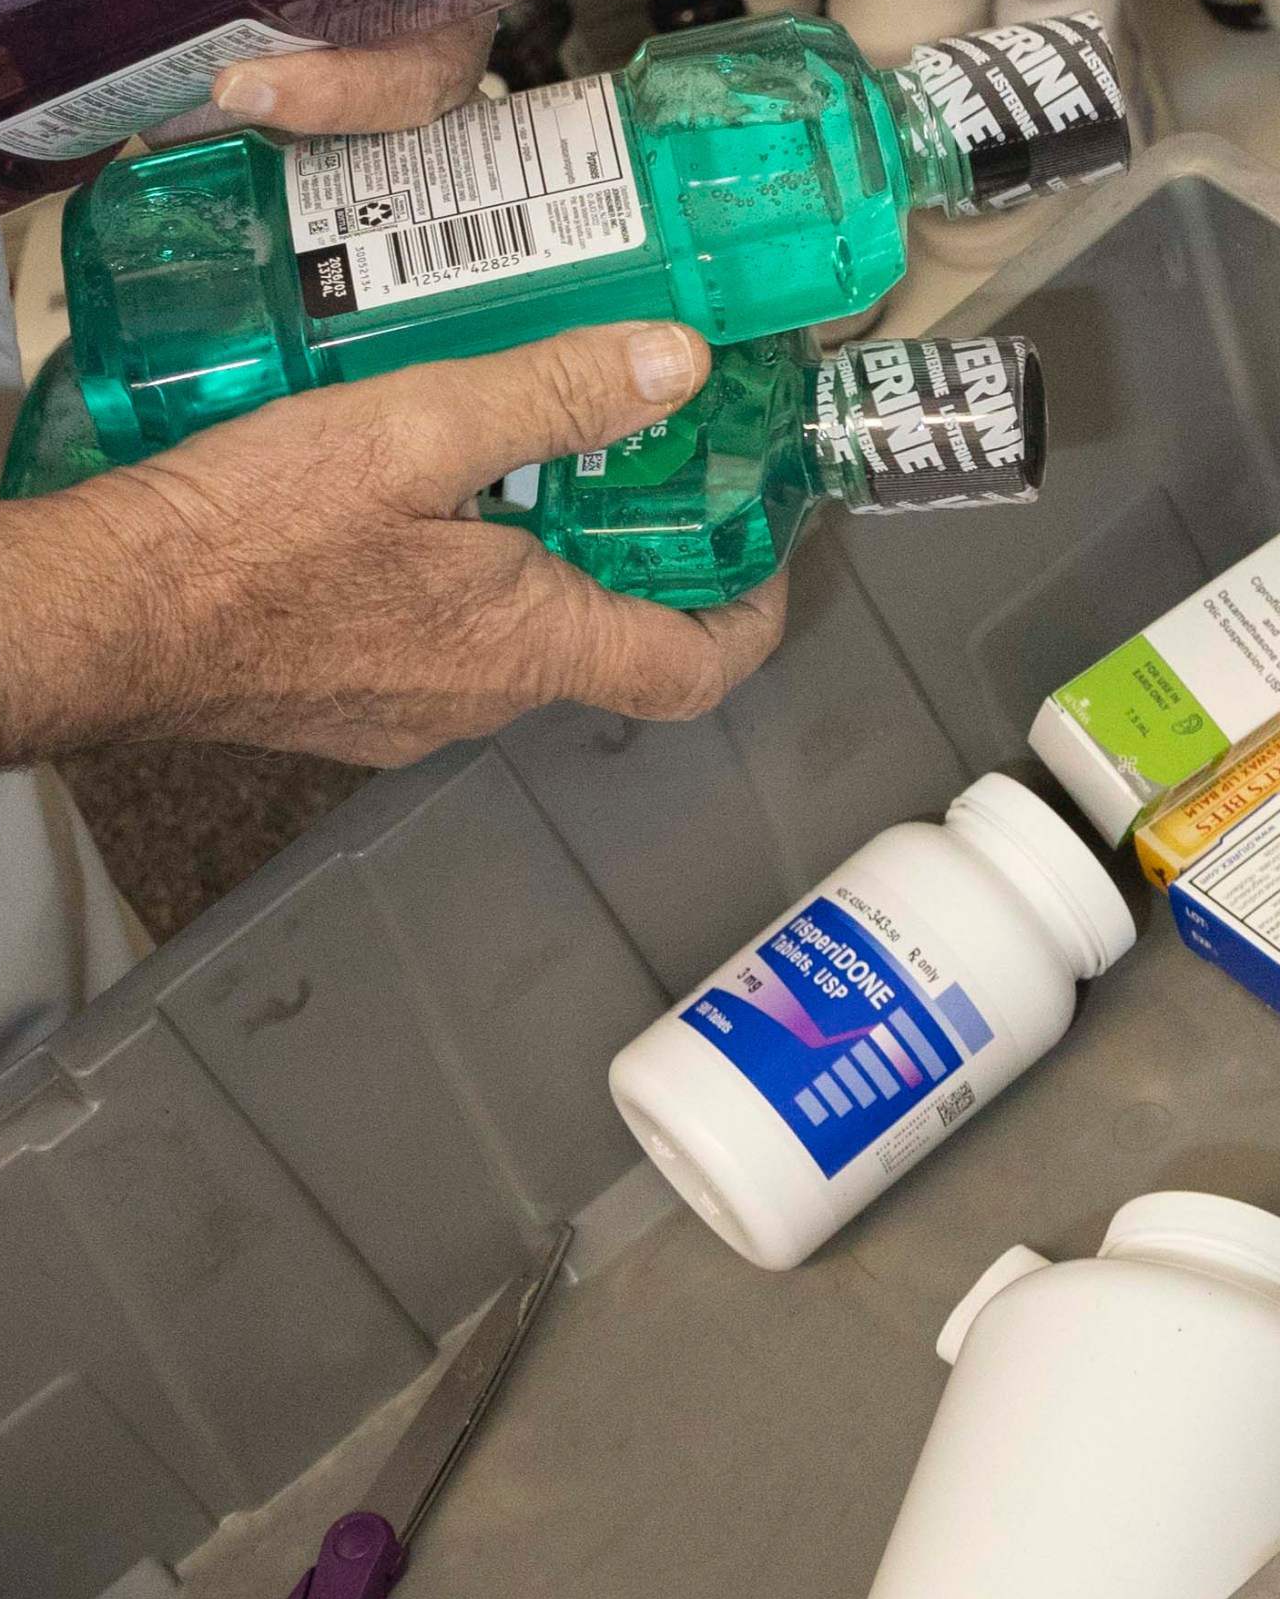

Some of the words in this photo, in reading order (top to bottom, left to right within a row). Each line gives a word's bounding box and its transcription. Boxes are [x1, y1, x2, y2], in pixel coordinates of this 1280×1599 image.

[1079, 40, 1126, 120] LISTERINE
[986, 66, 1039, 140] LISTERINE
[586, 151, 601, 179] Purposes
[335, 210, 347, 232] BOTTLE
[344, 207, 356, 230] PLASTIC
[603, 188, 615, 217] CONSUMER
[611, 187, 622, 212] JOHNSON
[618, 217, 629, 243] JOHNSON
[316, 261, 334, 297] 13724L
[326, 256, 348, 297] 2026/03
[353, 246, 373, 291] 30052134
[413, 266, 462, 287] 12547
[469, 252, 520, 274] 42825
[543, 248, 551, 257] 5
[939, 404, 978, 473] LISTERINE
[1203, 598, 1222, 618] Otic
[1218, 618, 1267, 675] Suspension,
[1218, 589, 1278, 661] Dexamethasone
[1262, 617, 1280, 636] and
[1132, 669, 1152, 691] EARS
[1148, 689, 1169, 712] ONLY
[1143, 661, 1160, 679] FOR
[1156, 677, 1173, 695] USE
[1170, 693, 1180, 704] IN
[1135, 721, 1150, 737] mL
[1220, 775, 1239, 792] LIP
[1184, 792, 1217, 818] BALM
[1194, 793, 1247, 835] BEES
[1198, 823, 1275, 885] www.DIUREX.com
[737, 966, 750, 980] 3
[771, 933, 817, 976] Tablets,
[812, 968, 848, 1003] USP
[790, 911, 895, 1009] risperiDONE
[915, 958, 941, 984] only
[742, 974, 762, 993] mg
[705, 1008, 733, 1034] Tablets
